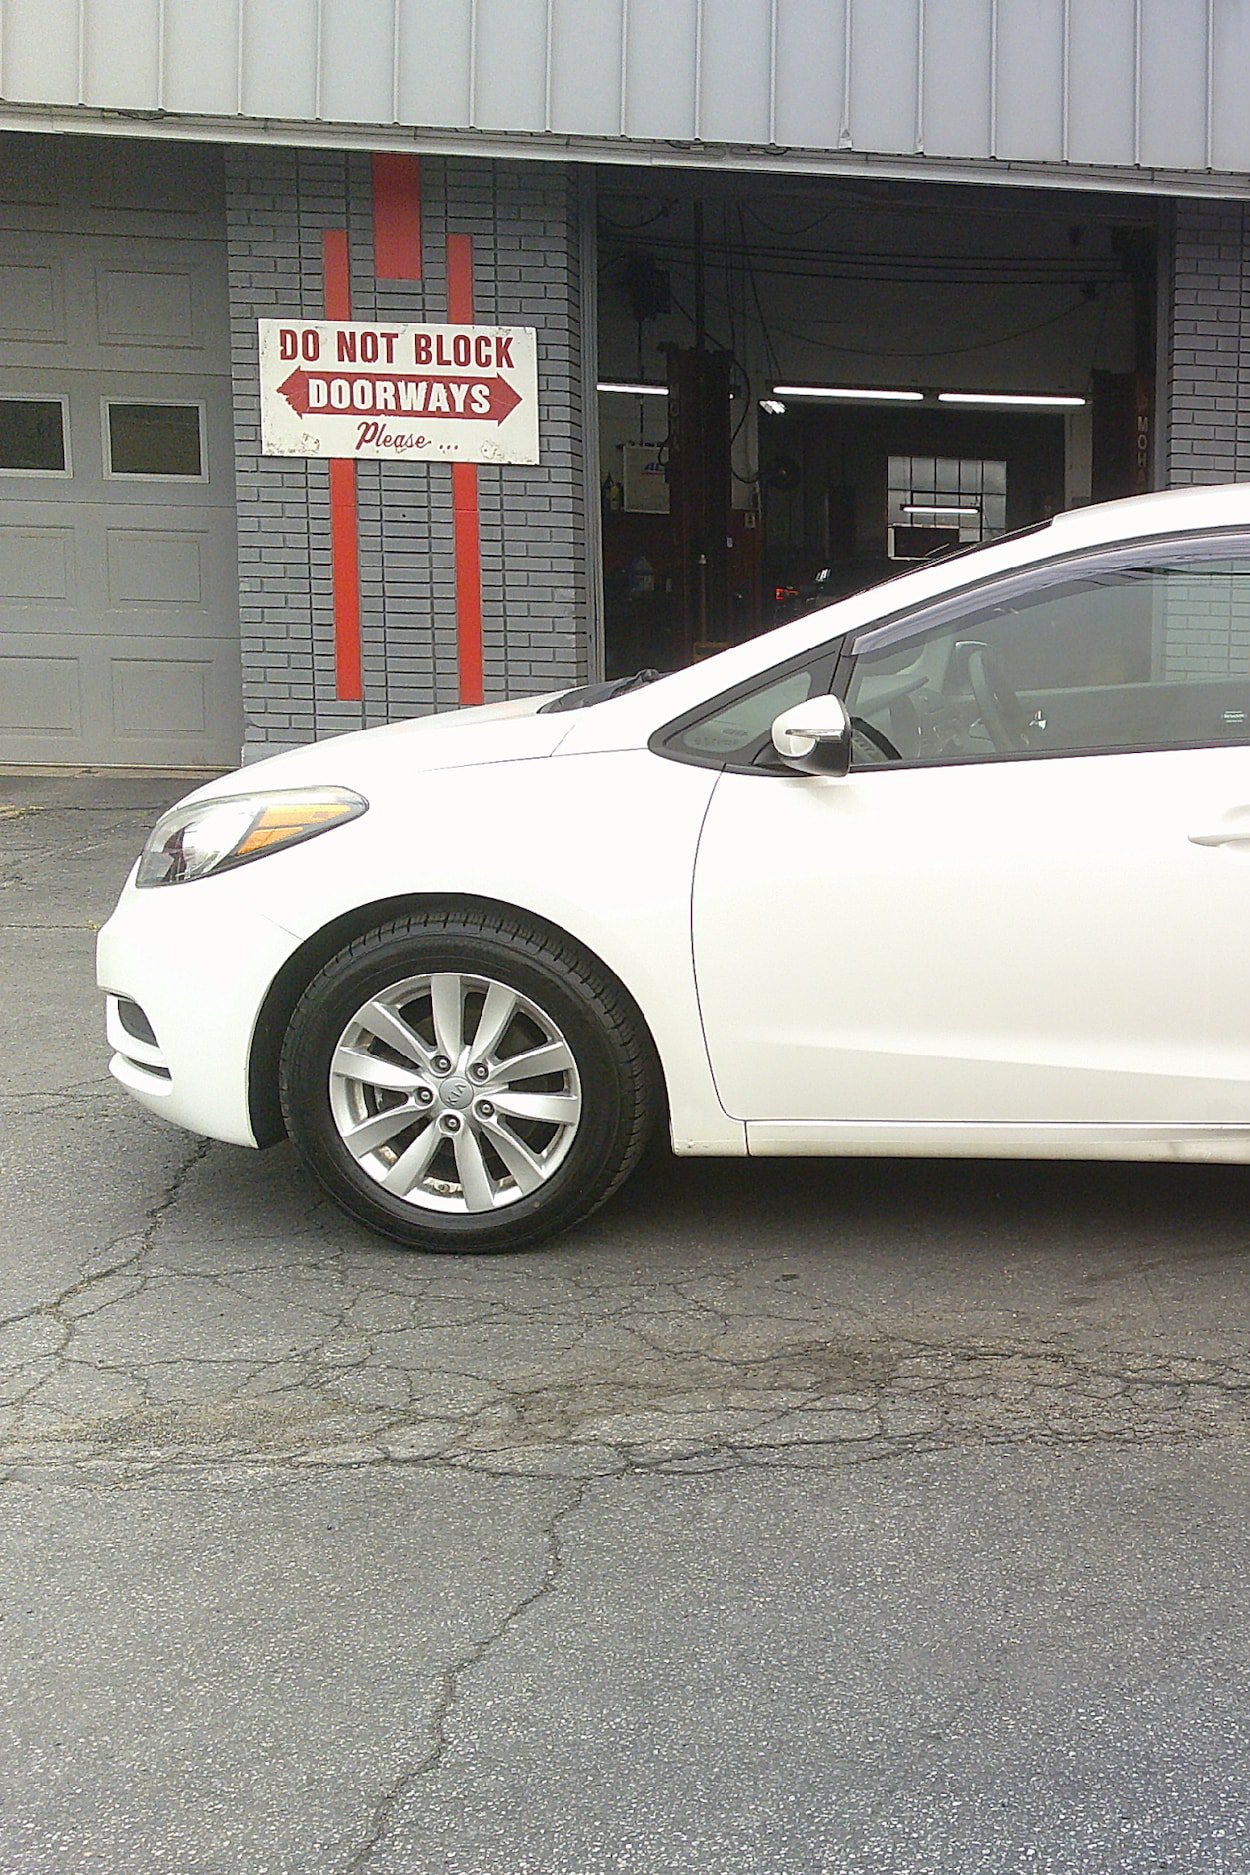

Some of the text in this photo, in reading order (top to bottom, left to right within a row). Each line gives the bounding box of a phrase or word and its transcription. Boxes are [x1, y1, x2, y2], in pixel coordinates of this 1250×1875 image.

[279, 329, 515, 369] DO NOT BLOCK
[308, 378, 491, 414] DOORWAYS
[446, 1083, 467, 1106] KIA
